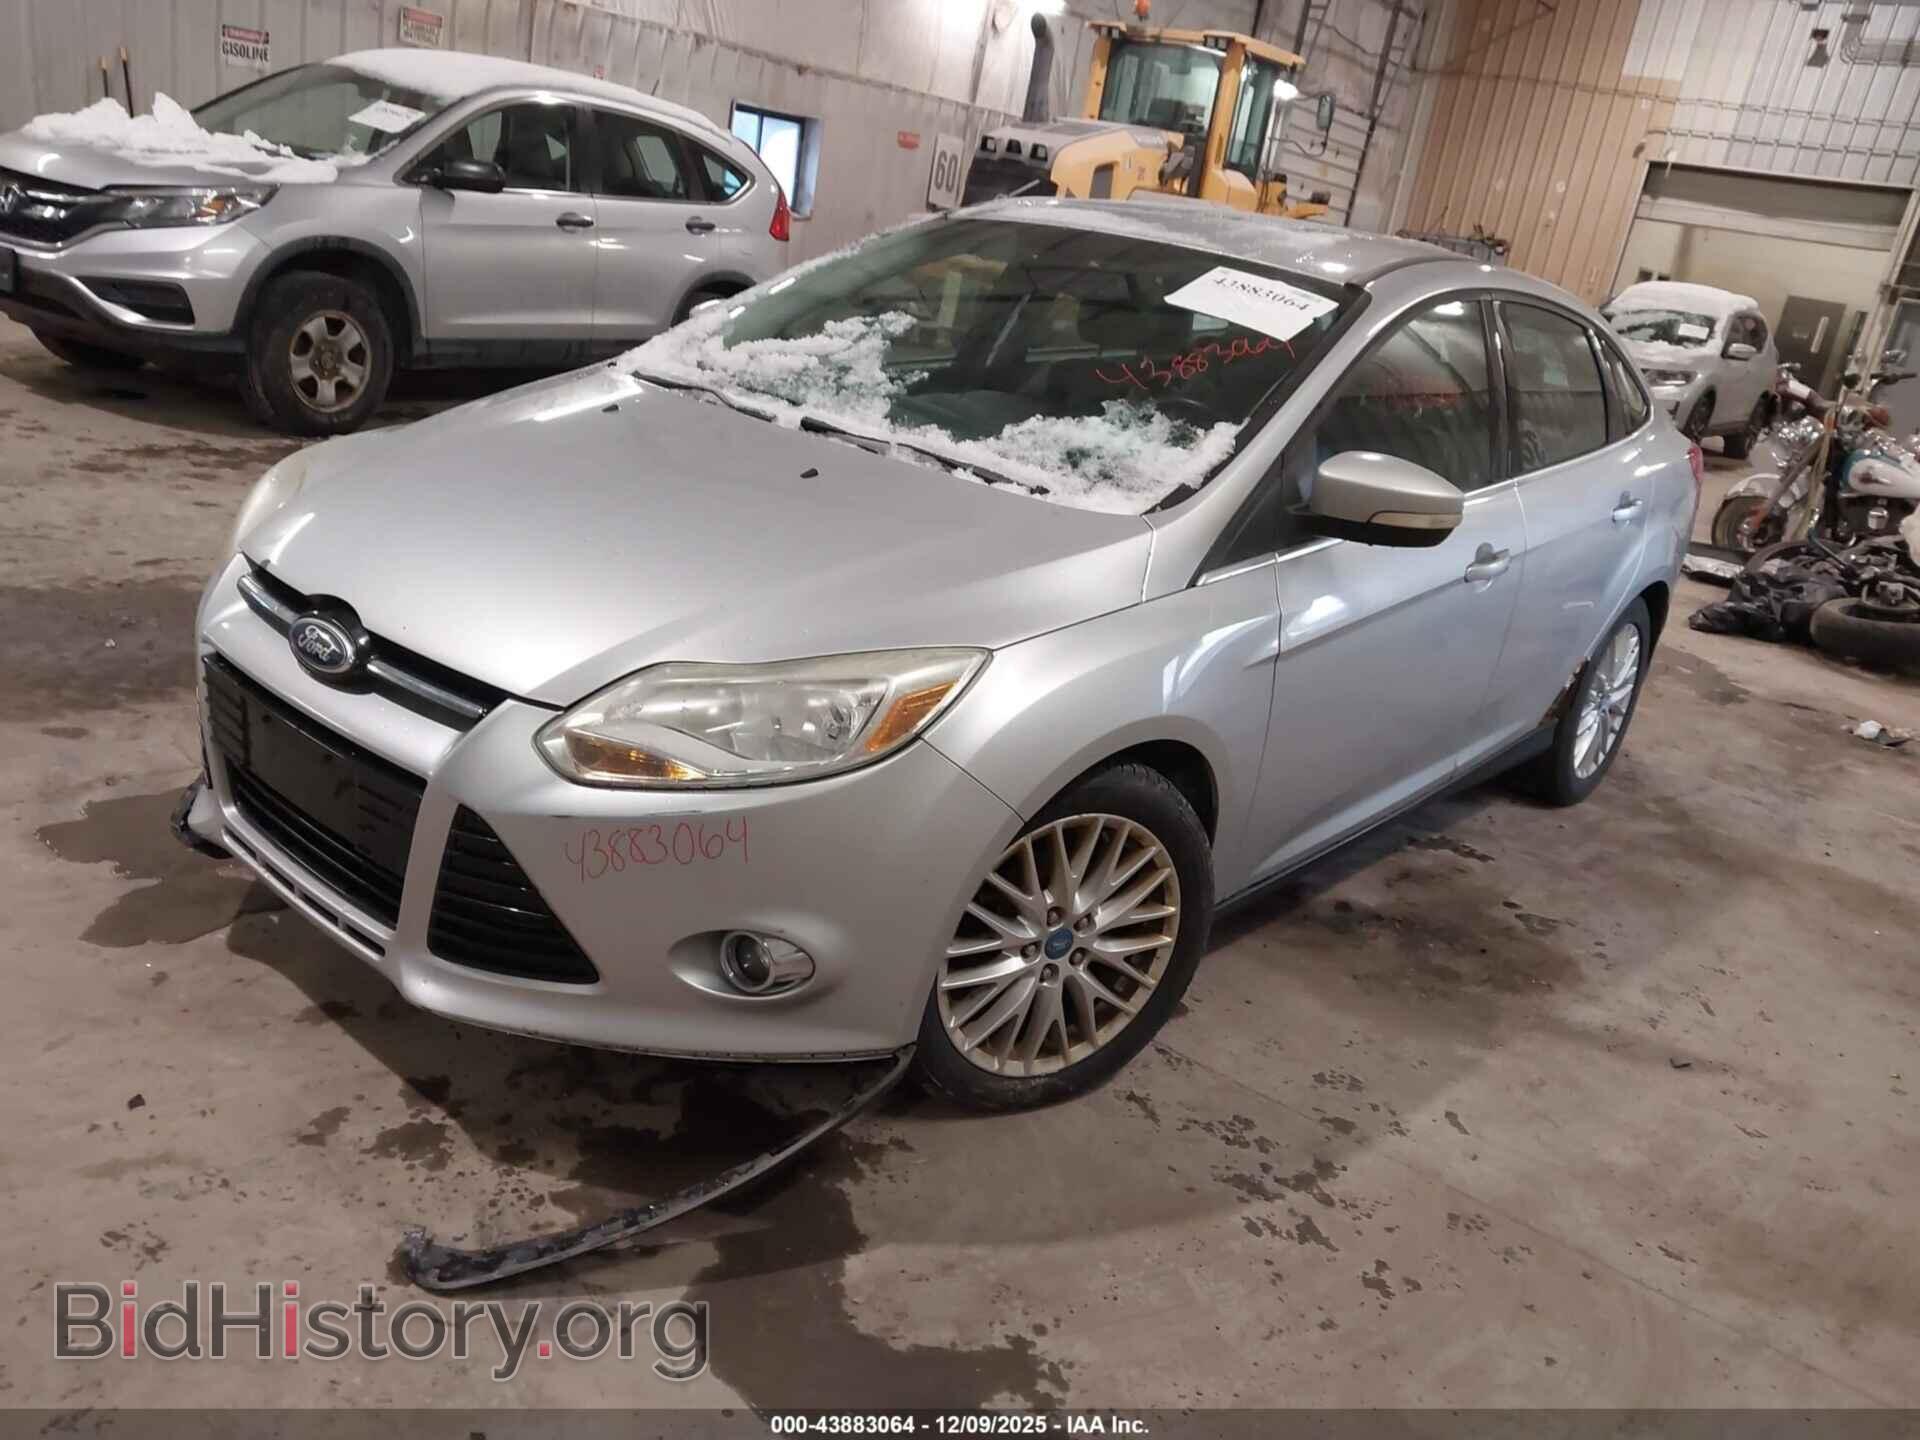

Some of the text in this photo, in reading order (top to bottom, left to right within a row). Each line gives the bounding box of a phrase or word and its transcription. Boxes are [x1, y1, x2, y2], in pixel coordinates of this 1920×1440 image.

[222, 41, 270, 62] GASOLINE
[935, 149, 959, 193] 60
[1213, 276, 1311, 311] 43883064
[298, 625, 341, 662] Ford
[564, 816, 749, 884] 43883064
